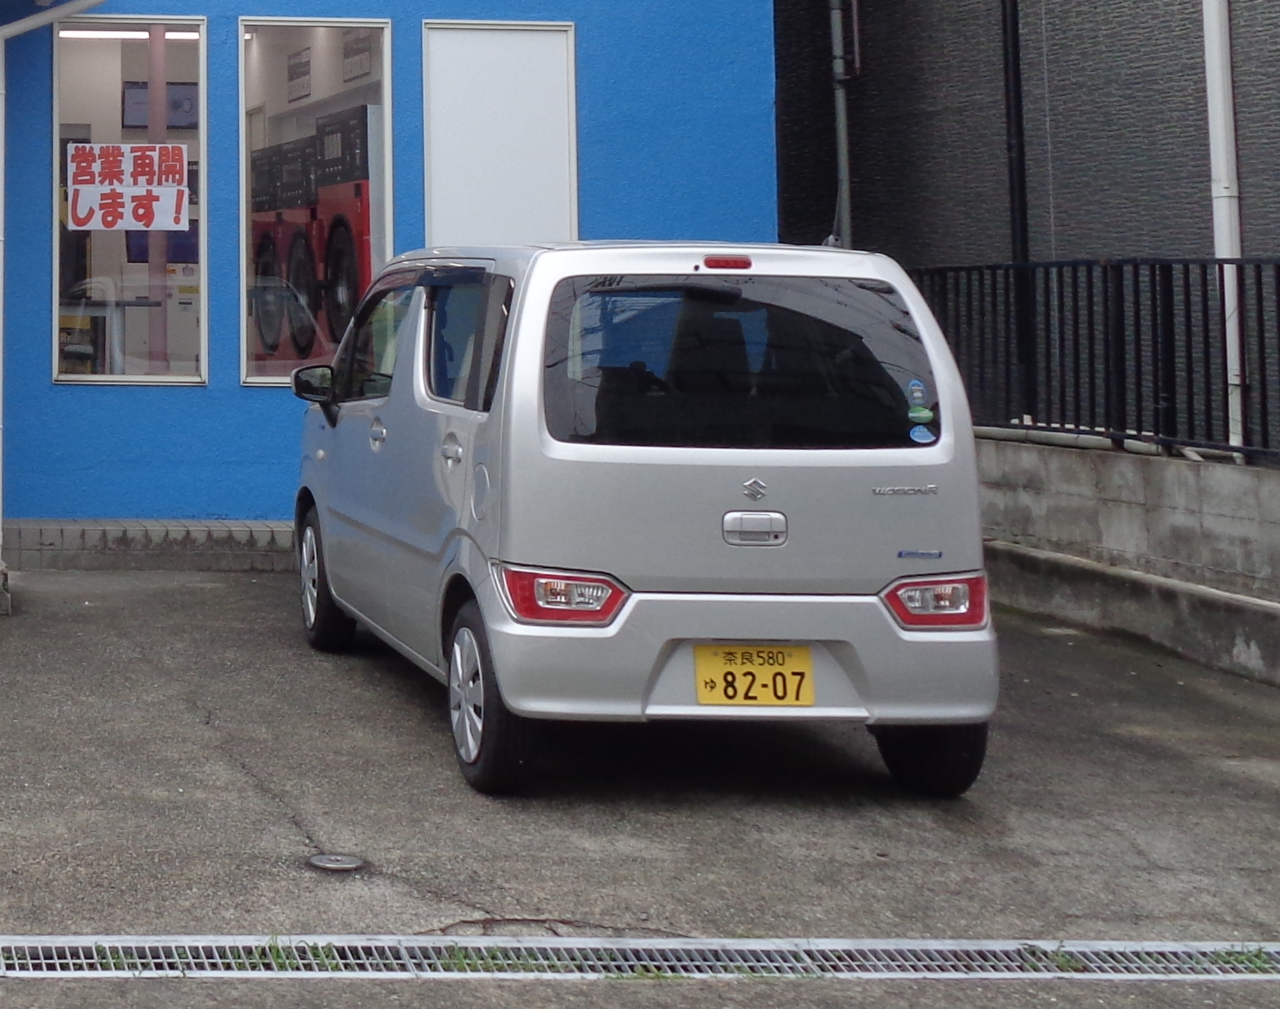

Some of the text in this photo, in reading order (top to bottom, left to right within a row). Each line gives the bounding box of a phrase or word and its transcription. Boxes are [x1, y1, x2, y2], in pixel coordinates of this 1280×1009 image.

[71, 145, 184, 186] 営業再開
[703, 670, 806, 701] ゆ 82-07
